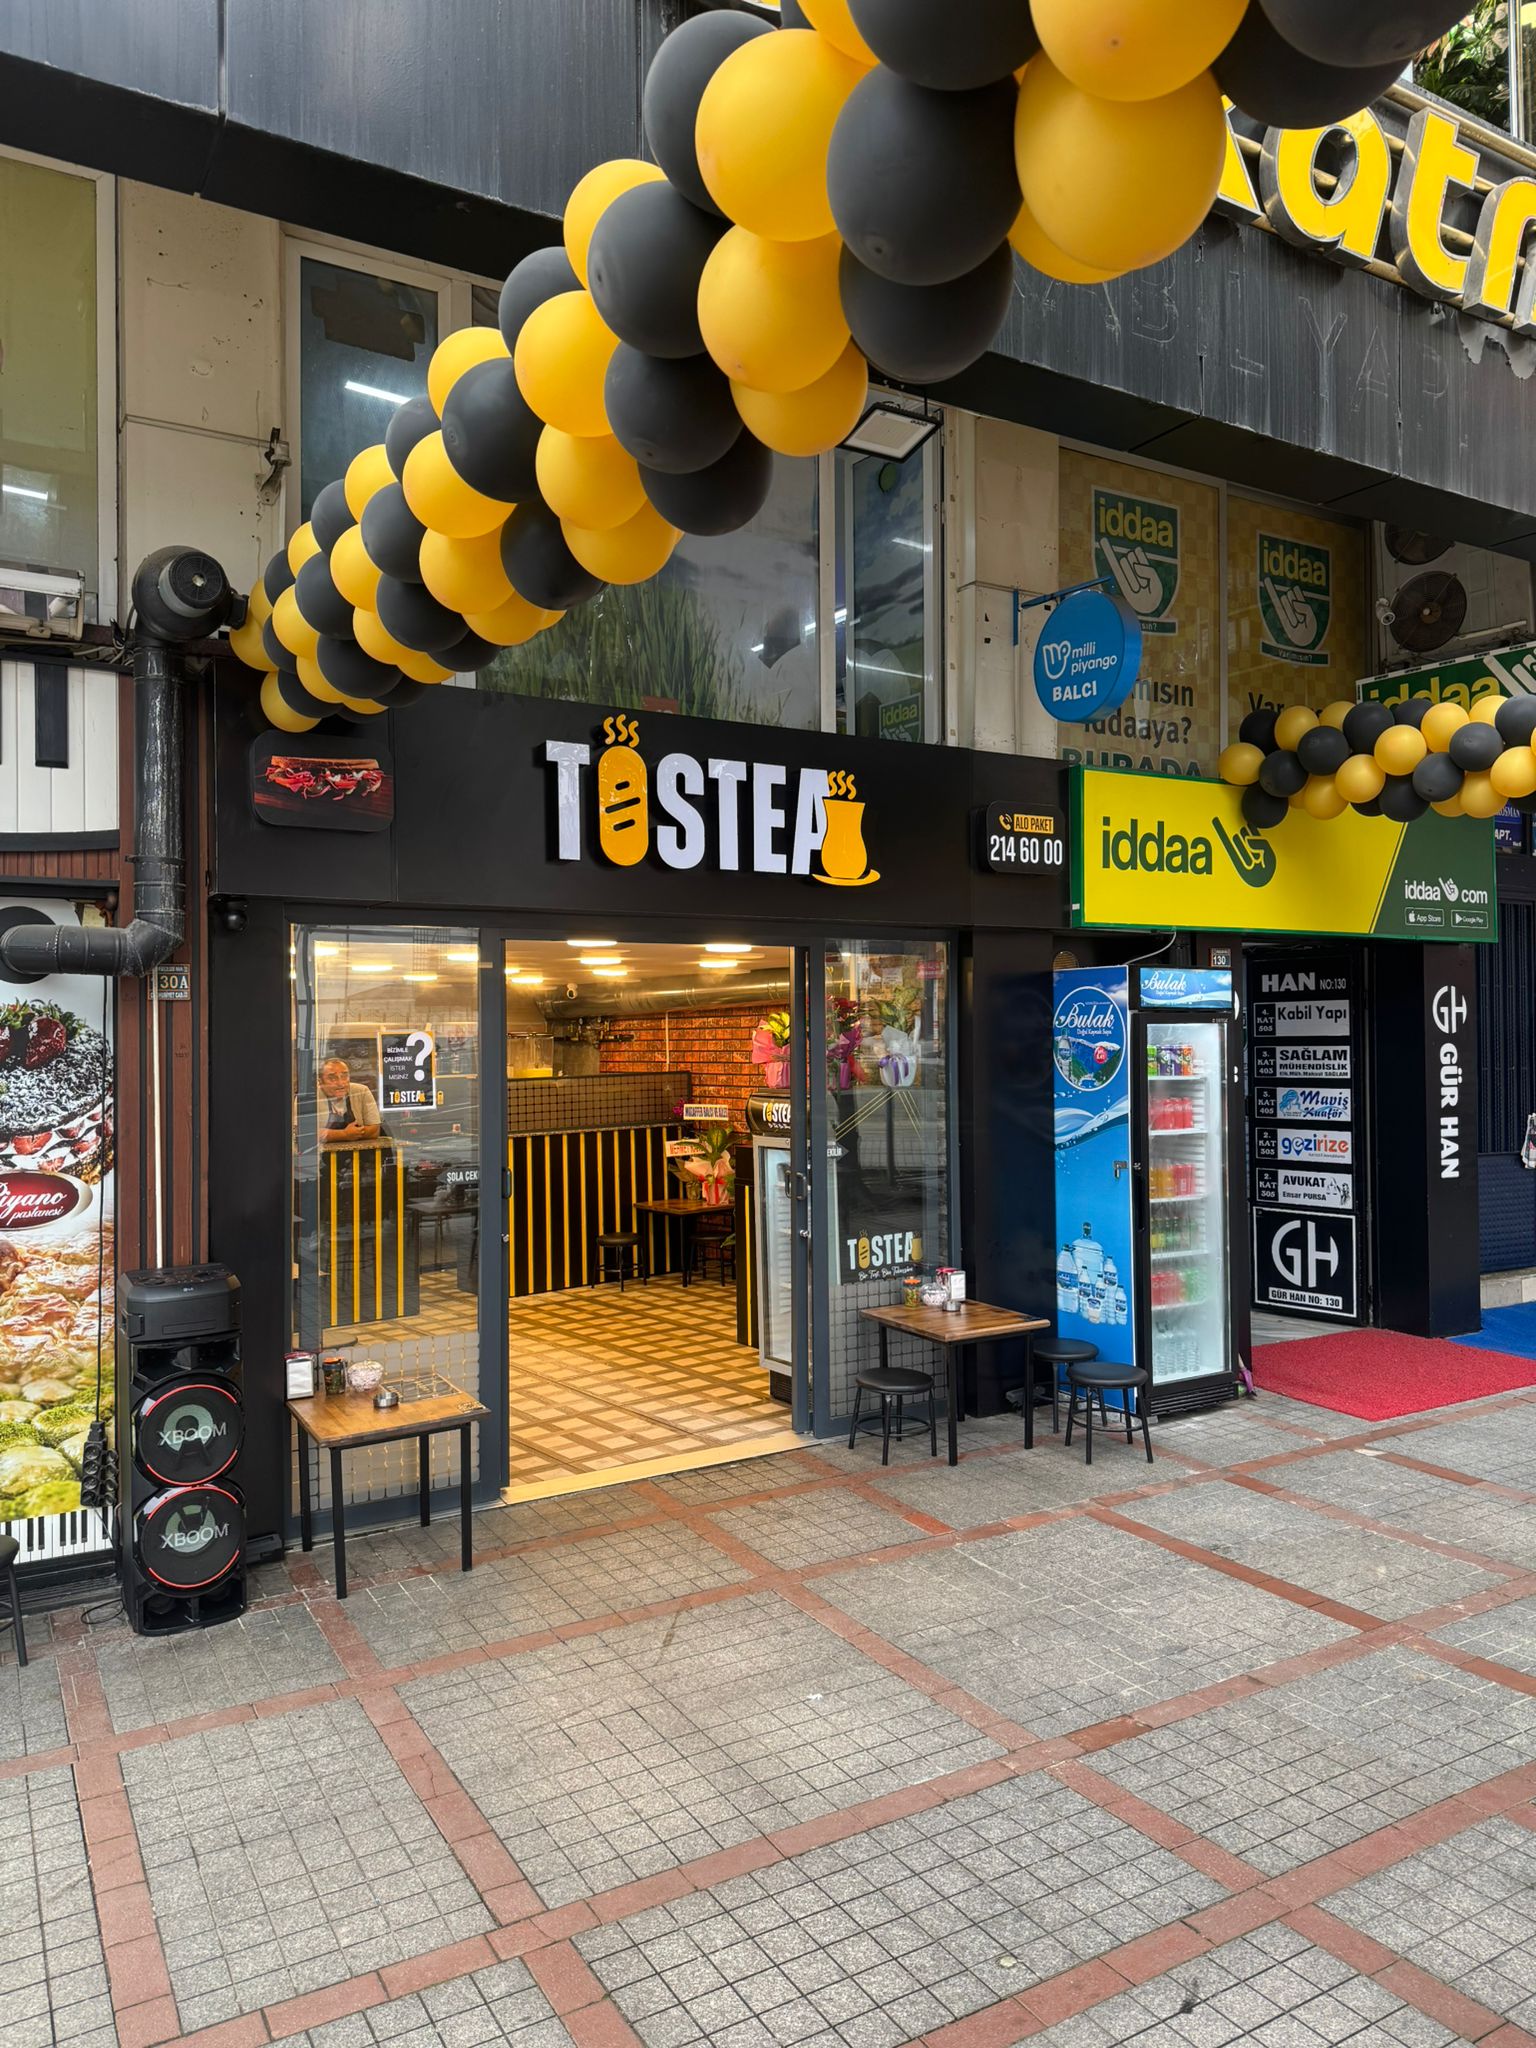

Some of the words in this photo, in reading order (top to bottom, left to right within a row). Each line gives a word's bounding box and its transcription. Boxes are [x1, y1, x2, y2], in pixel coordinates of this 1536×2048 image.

[1100, 497, 1174, 549] iddaa
[1263, 541, 1327, 588] iddaa
[1071, 641, 1096, 660] milli
[1071, 654, 1118, 676] piyango
[1052, 680, 1097, 702] BALCI
[1015, 816, 1029, 830] ALO
[1030, 817, 1053, 832] PAKET
[990, 834, 1016, 862] 214
[1020, 836, 1039, 864] 60
[1043, 838, 1063, 865] 00
[1102, 815, 1213, 875] iddaa
[1404, 879, 1441, 901] iddaa
[1461, 889, 1488, 904] com
[1416, 914, 1427, 923] App
[1213, 955, 1227, 965] 130
[1141, 970, 1187, 991] Bulak
[1261, 972, 1316, 993] HAN
[1319, 978, 1347, 991] NO:130
[1055, 1001, 1115, 1029] Bulak
[1256, 1016, 1275, 1024] KAT
[1277, 1004, 1312, 1020] Kabil
[1315, 1005, 1347, 1024] Yapı
[1257, 1058, 1276, 1066] KAT
[1279, 1046, 1348, 1061] SAĞLAM
[1279, 1062, 1348, 1071] MÜHENDİSLİK
[1439, 1042, 1463, 1109] GÜR
[1299, 1090, 1349, 1111] Maviş
[1303, 1107, 1343, 1119] Kuaför
[1281, 1133, 1350, 1156] gezirize
[1440, 1116, 1460, 1179] HAN
[464, 1170, 480, 1183] ÇEK
[1259, 1181, 1277, 1189] KAT
[1283, 1175, 1326, 1188] AVUKAT
[6, 1206, 65, 1226] pastanesi
[1271, 1219, 1339, 1288] GH
[1271, 1289, 1288, 1300] GÜR
[1289, 1292, 1306, 1302] HAN
[1308, 1295, 1323, 1305] NO:
[1324, 1297, 1340, 1307] 130
[159, 1422, 227, 1446] XBOOM
[161, 1524, 228, 1549] XBOOM
